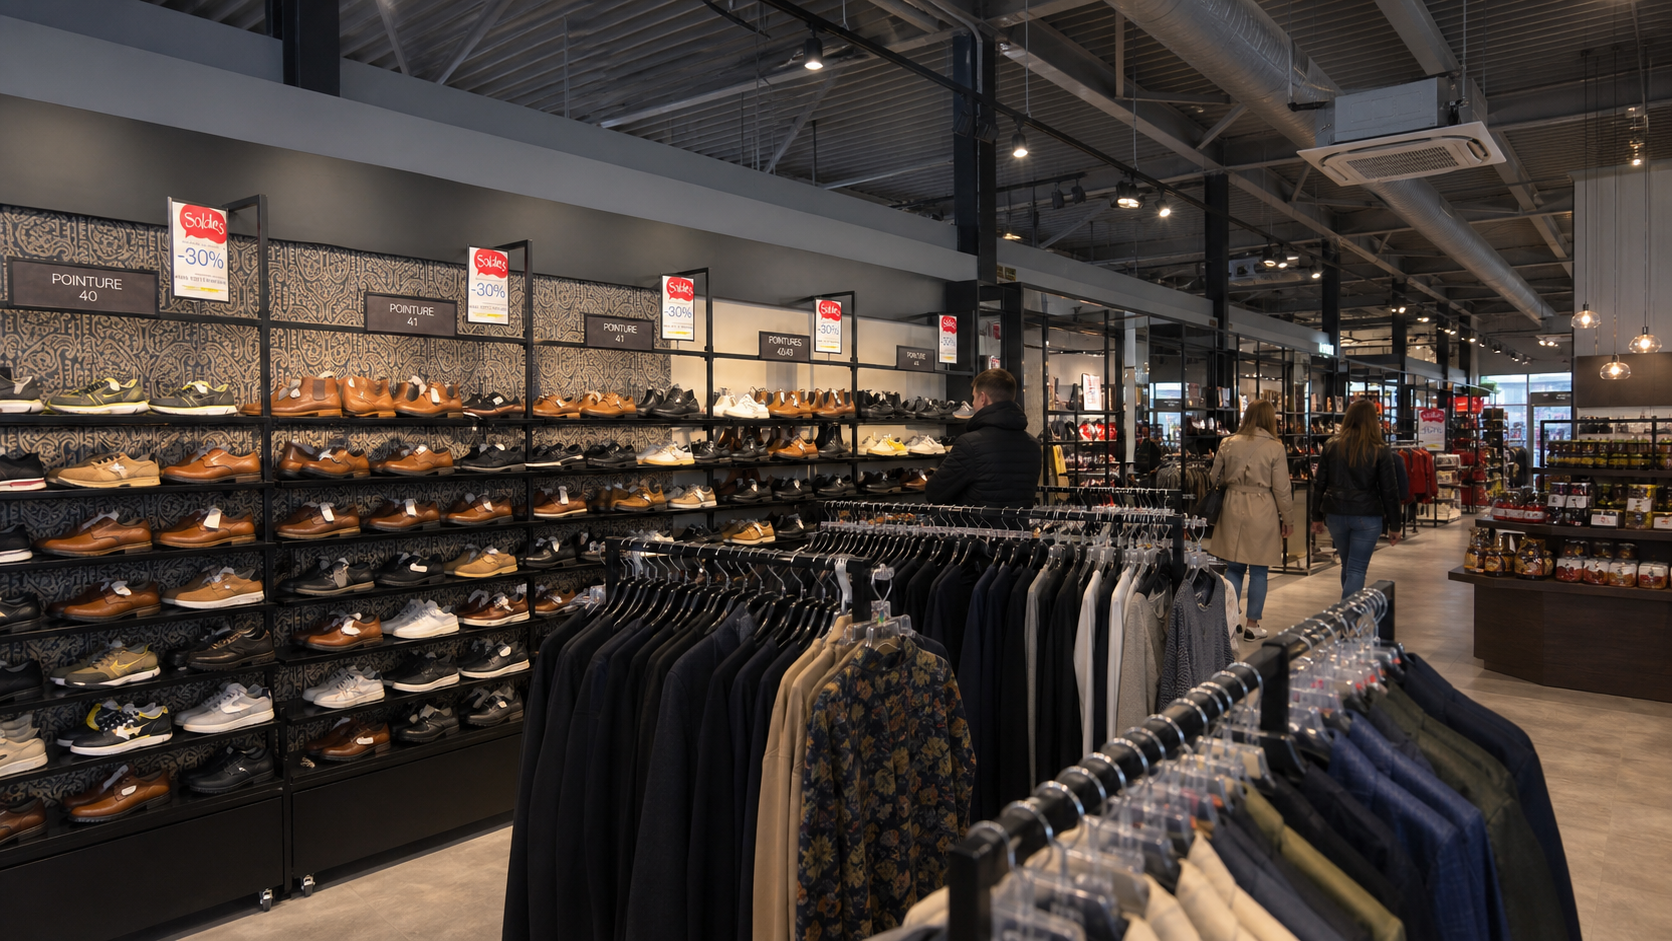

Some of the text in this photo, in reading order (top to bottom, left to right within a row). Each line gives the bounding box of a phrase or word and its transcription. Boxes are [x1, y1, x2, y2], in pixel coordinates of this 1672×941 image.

[184, 211, 225, 235] Soldes
[177, 247, 224, 270] -30%
[476, 254, 507, 272] Soldes
[52, 273, 122, 290] POINTURE
[79, 290, 98, 302] 40
[471, 282, 506, 299] -30%
[389, 303, 435, 317] POINTURE
[664, 305, 692, 318] -30%
[407, 316, 418, 327] 41
[603, 322, 637, 334] POINTURE
[615, 334, 625, 343] 41
